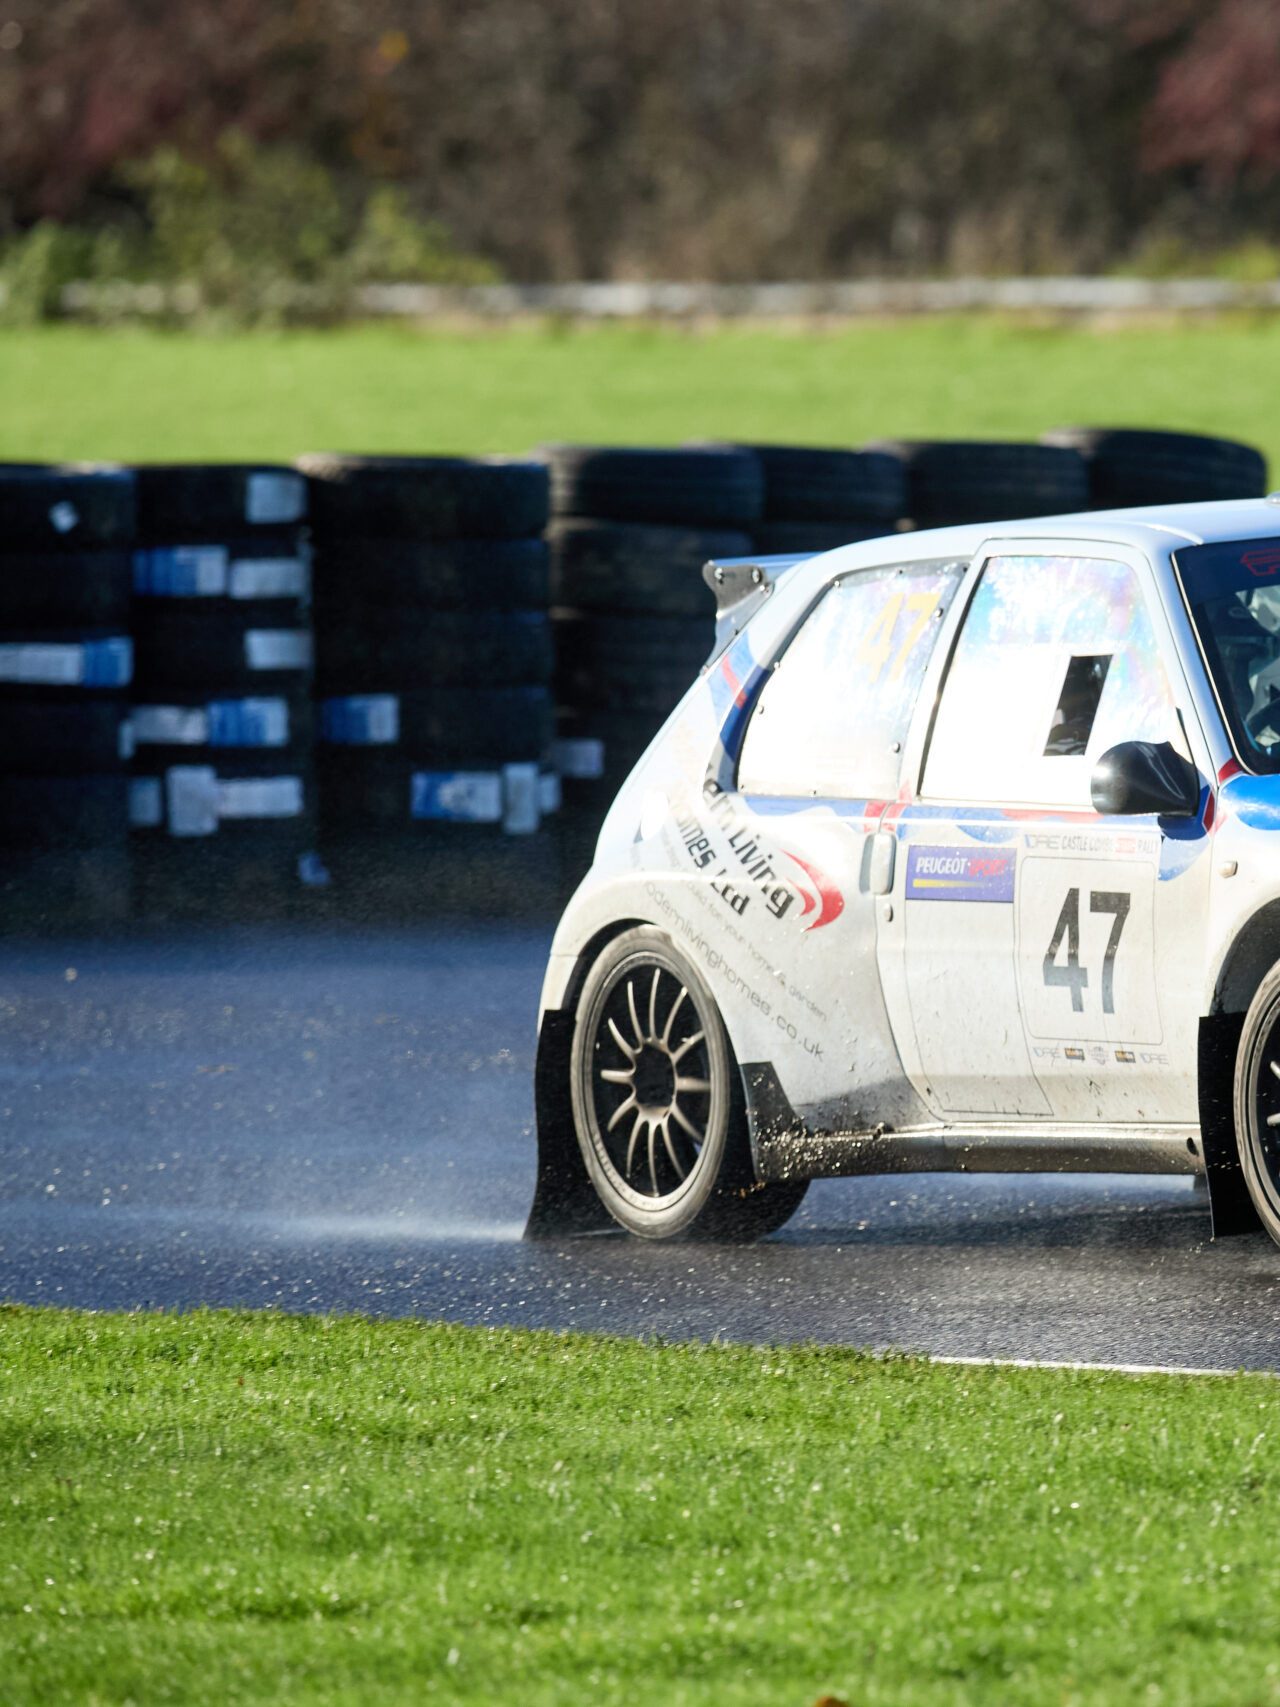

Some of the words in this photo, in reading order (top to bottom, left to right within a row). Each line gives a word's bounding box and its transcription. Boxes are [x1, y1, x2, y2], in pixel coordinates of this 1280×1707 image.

[854, 592, 941, 683] 47
[728, 825, 796, 919] Living
[915, 856, 968, 875] PEUGEOT
[967, 857, 1008, 877] SPORT
[645, 880, 825, 1062] odernlivinghomes.co.uk
[1043, 887, 1131, 1014] 47
